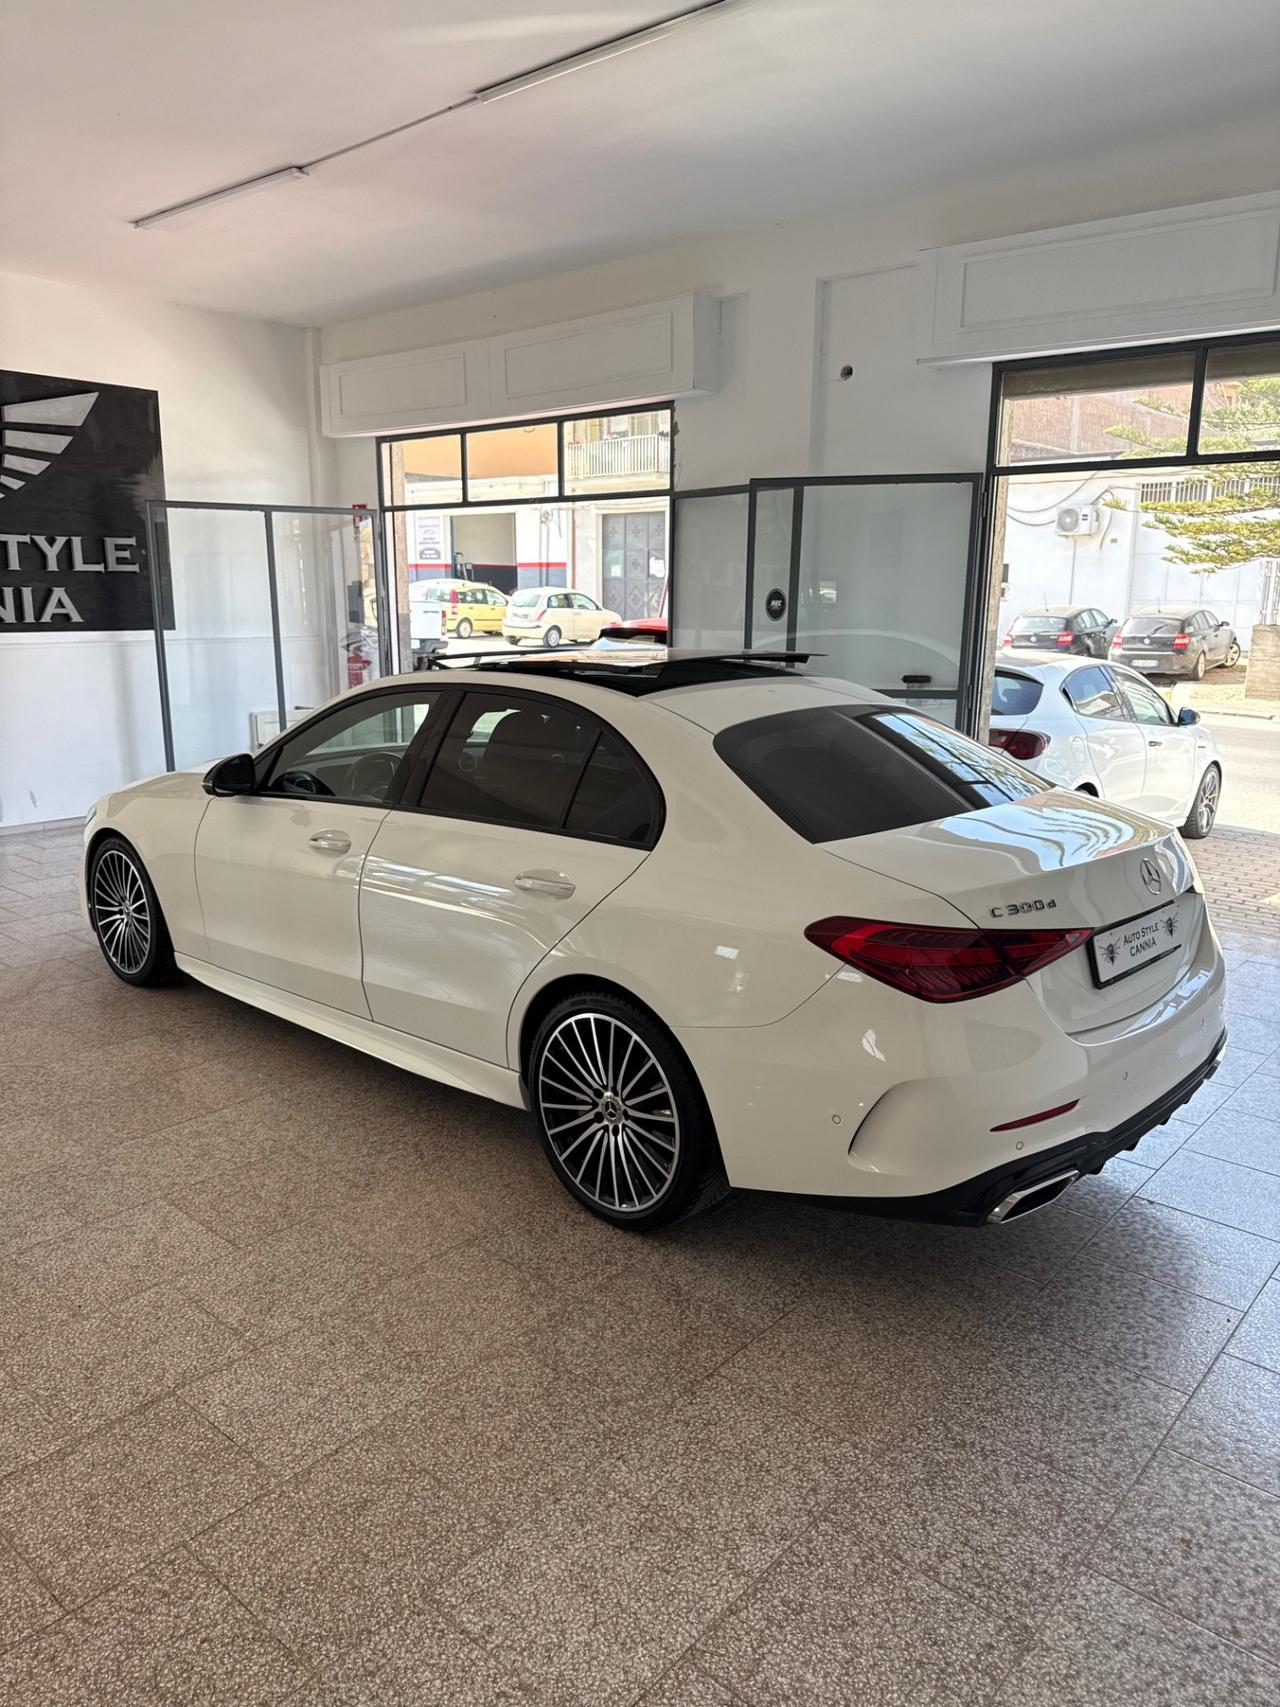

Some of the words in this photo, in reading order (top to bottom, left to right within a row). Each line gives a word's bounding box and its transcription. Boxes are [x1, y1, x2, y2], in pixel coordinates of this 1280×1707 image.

[0, 532, 140, 573] TYLE
[989, 907, 1004, 919] C
[1129, 936, 1157, 957] CANNIA
